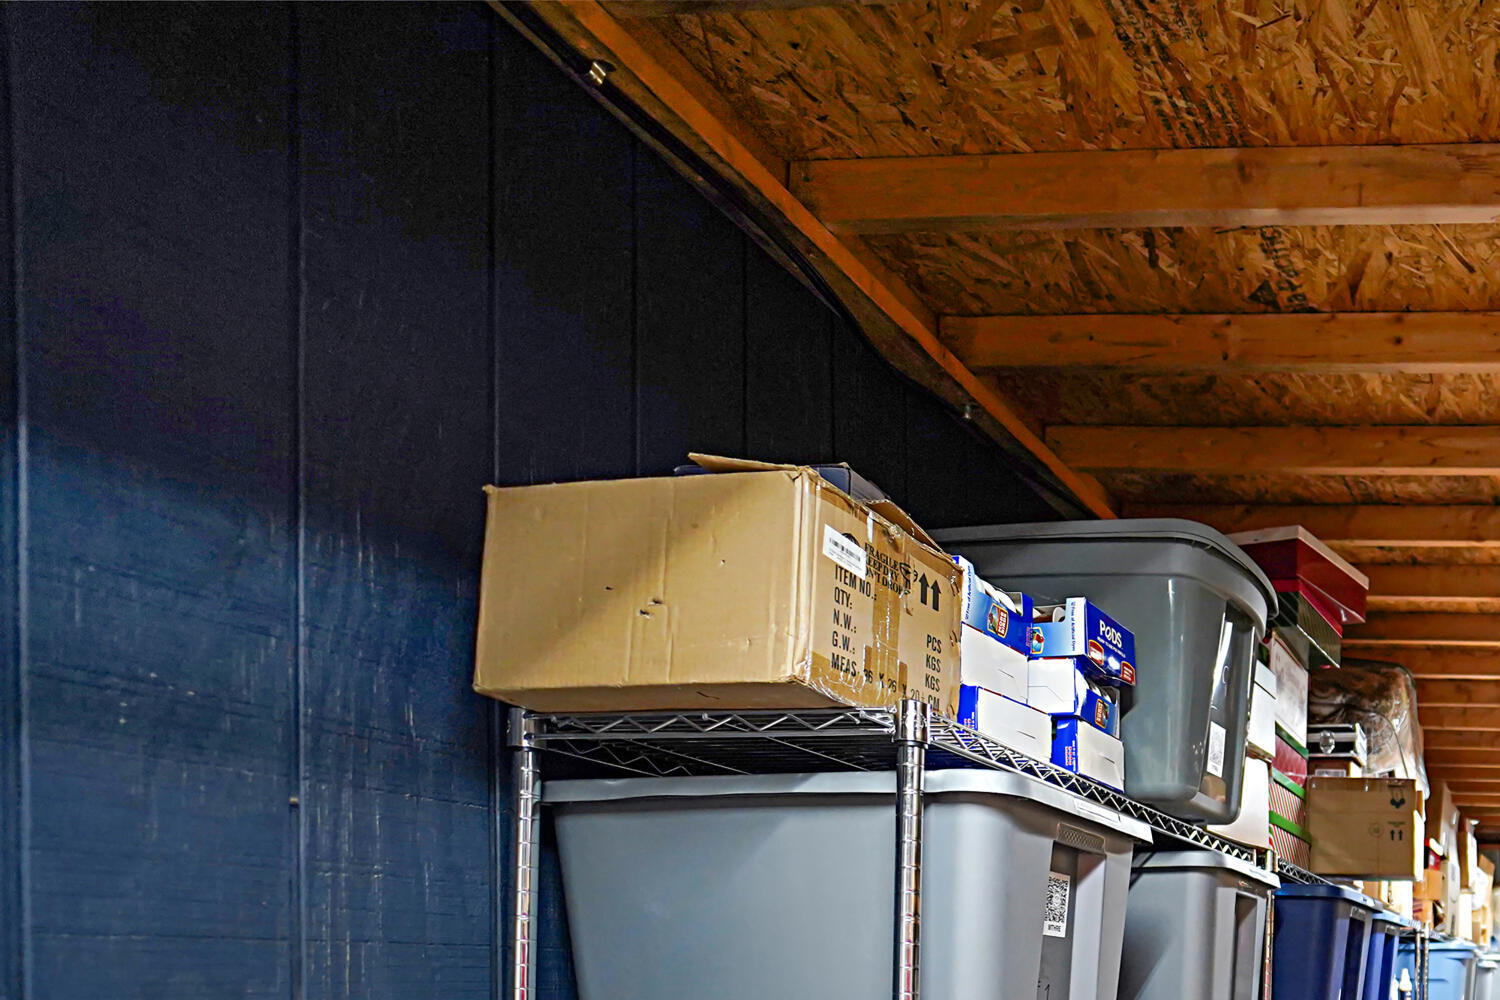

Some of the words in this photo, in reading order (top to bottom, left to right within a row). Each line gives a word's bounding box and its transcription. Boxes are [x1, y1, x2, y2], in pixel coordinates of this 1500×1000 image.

[834, 565, 857, 594] ITEM
[834, 587, 853, 610] QTY:
[926, 634, 942, 654] PCS
[925, 653, 941, 673] KGS
[925, 673, 940, 693] KGS
